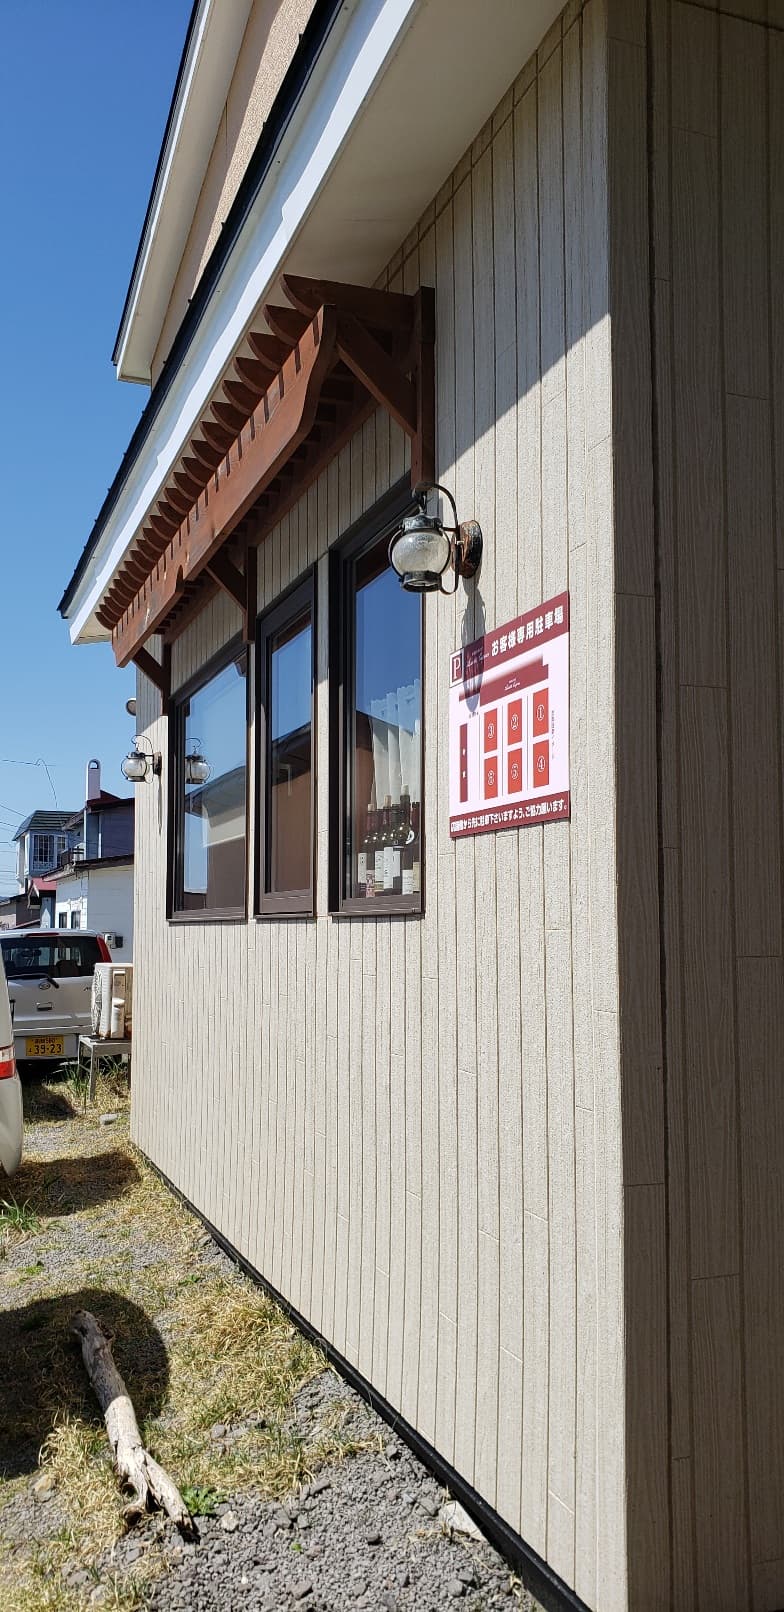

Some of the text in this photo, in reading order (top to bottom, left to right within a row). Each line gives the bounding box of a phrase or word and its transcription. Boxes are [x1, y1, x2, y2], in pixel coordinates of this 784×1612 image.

[491, 605, 564, 657] お客様専用駐車場
[452, 657, 461, 680] P
[536, 704, 545, 721] ①
[536, 755, 546, 773] ④
[34, 1044, 62, 1054] 39-23
